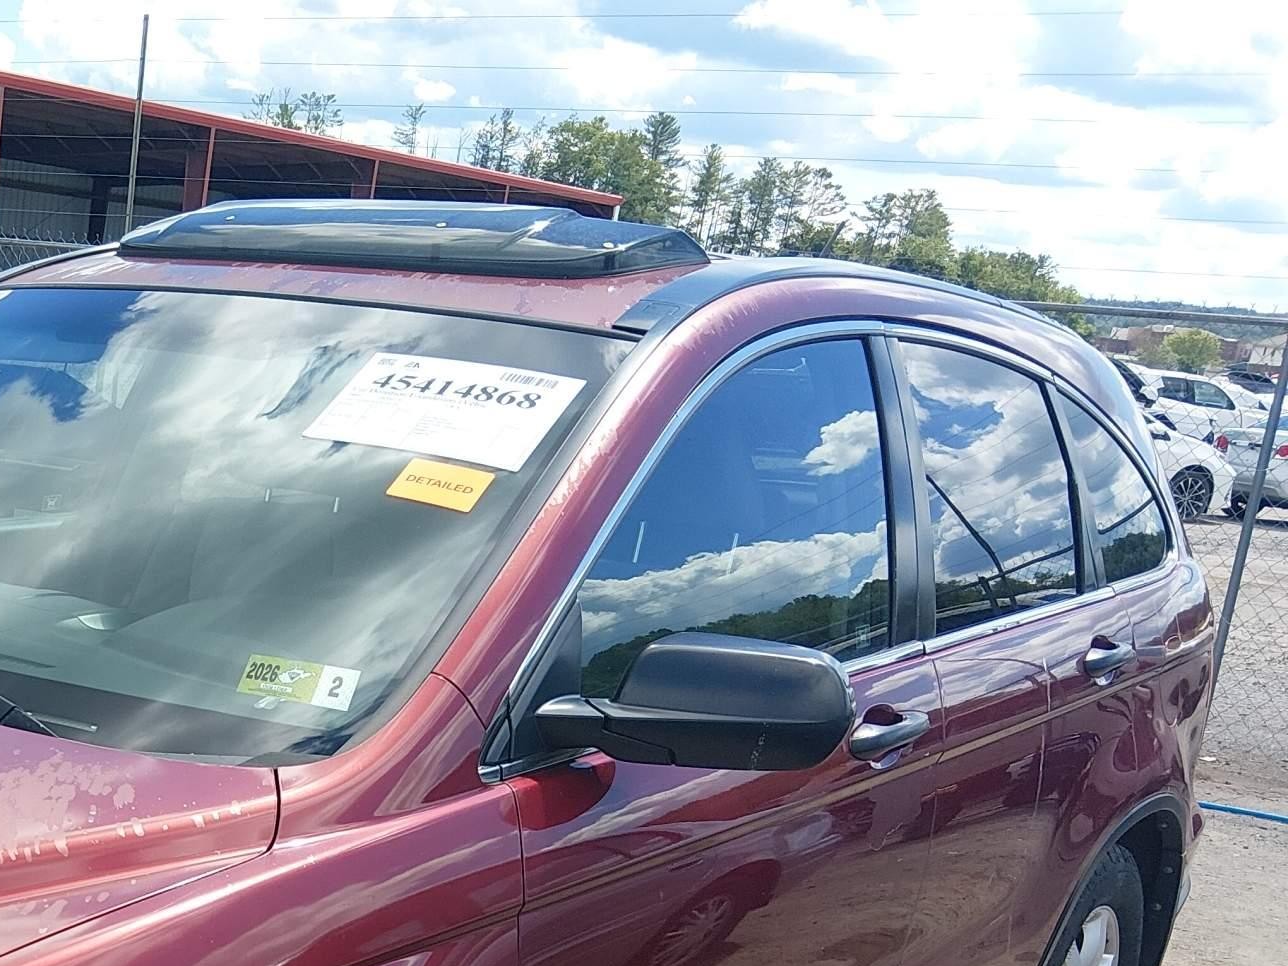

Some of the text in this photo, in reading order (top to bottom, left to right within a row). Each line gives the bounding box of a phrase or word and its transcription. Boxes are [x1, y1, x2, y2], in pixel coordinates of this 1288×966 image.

[372, 373, 542, 409] 45414868
[405, 474, 474, 494] DETAILED
[246, 661, 280, 683] 2026
[327, 676, 344, 698] 2
